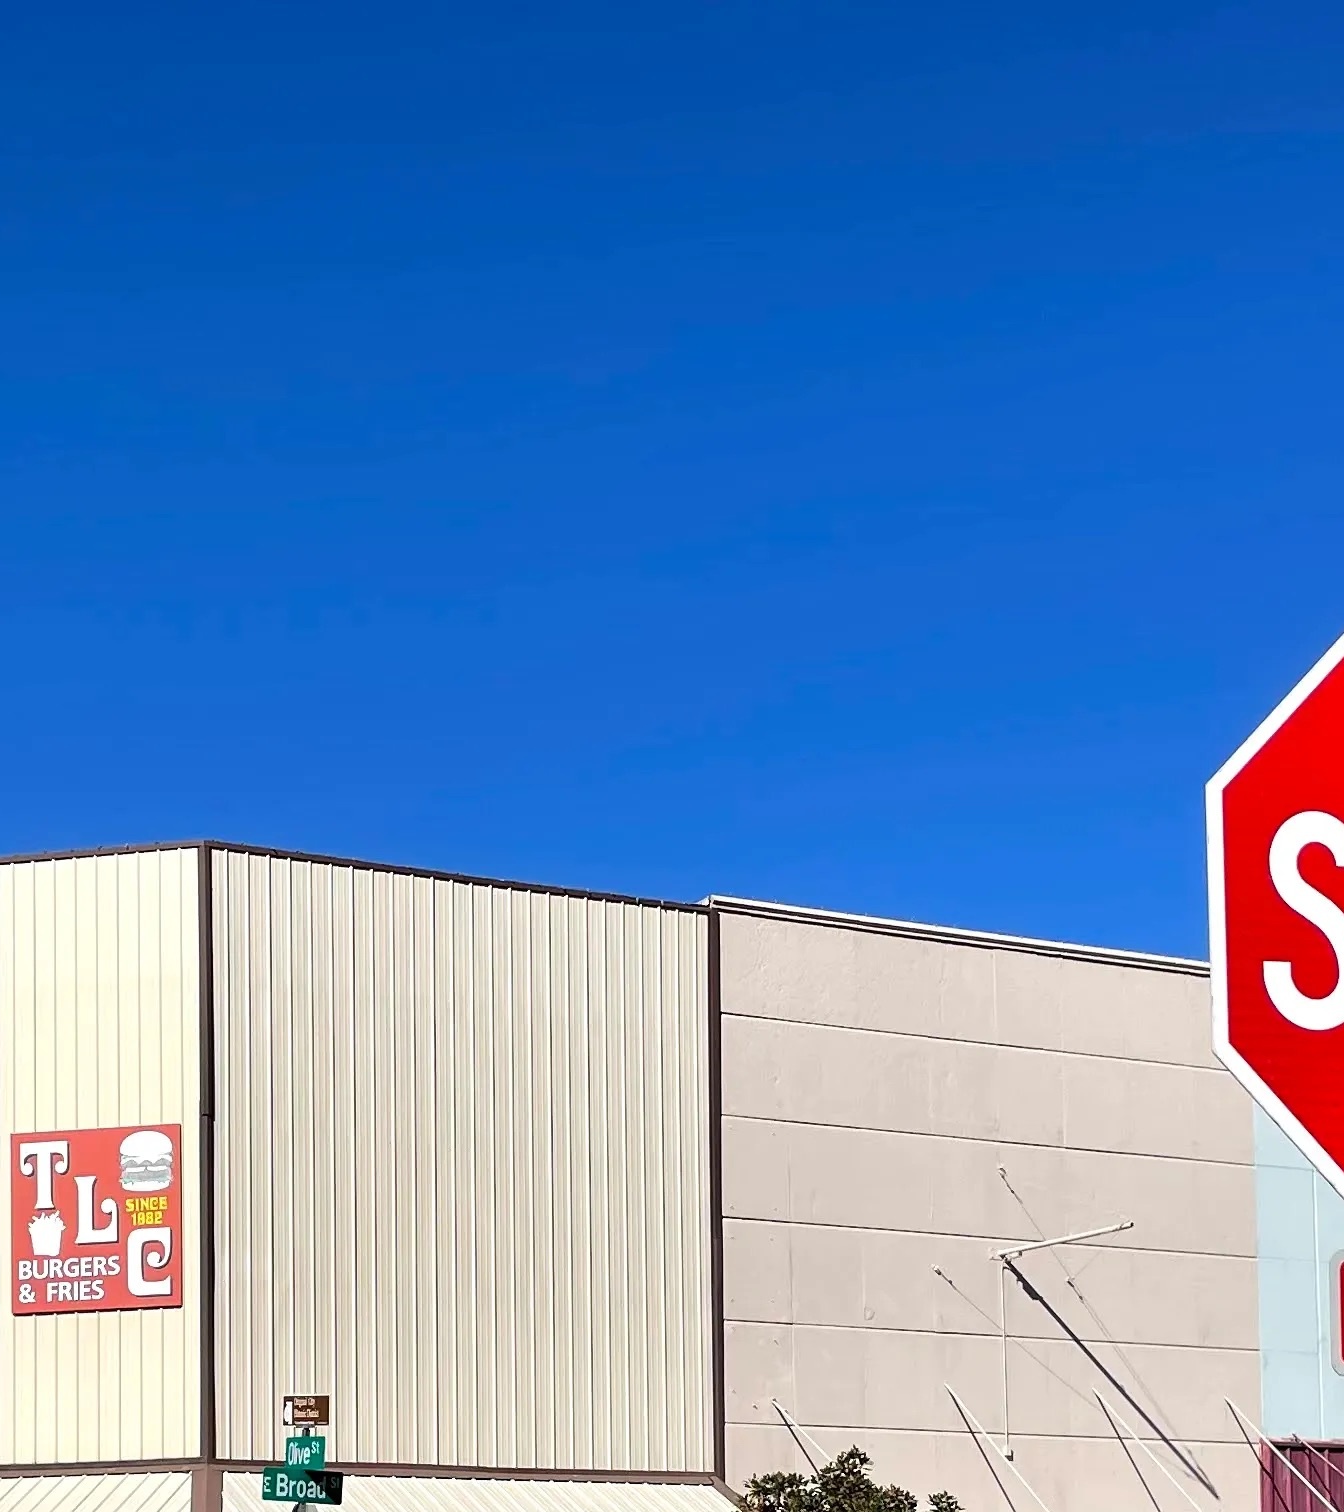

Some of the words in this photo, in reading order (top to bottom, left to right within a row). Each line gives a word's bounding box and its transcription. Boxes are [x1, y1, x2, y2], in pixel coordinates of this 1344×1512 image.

[125, 1196, 168, 1212] SINCE
[18, 1256, 121, 1281] BURGERS
[19, 1284, 36, 1303] &
[46, 1280, 105, 1303] FRIES
[287, 1441, 311, 1466] Olive
[311, 1440, 320, 1454] St
[263, 1476, 272, 1493] E
[276, 1472, 326, 1499] Broad
